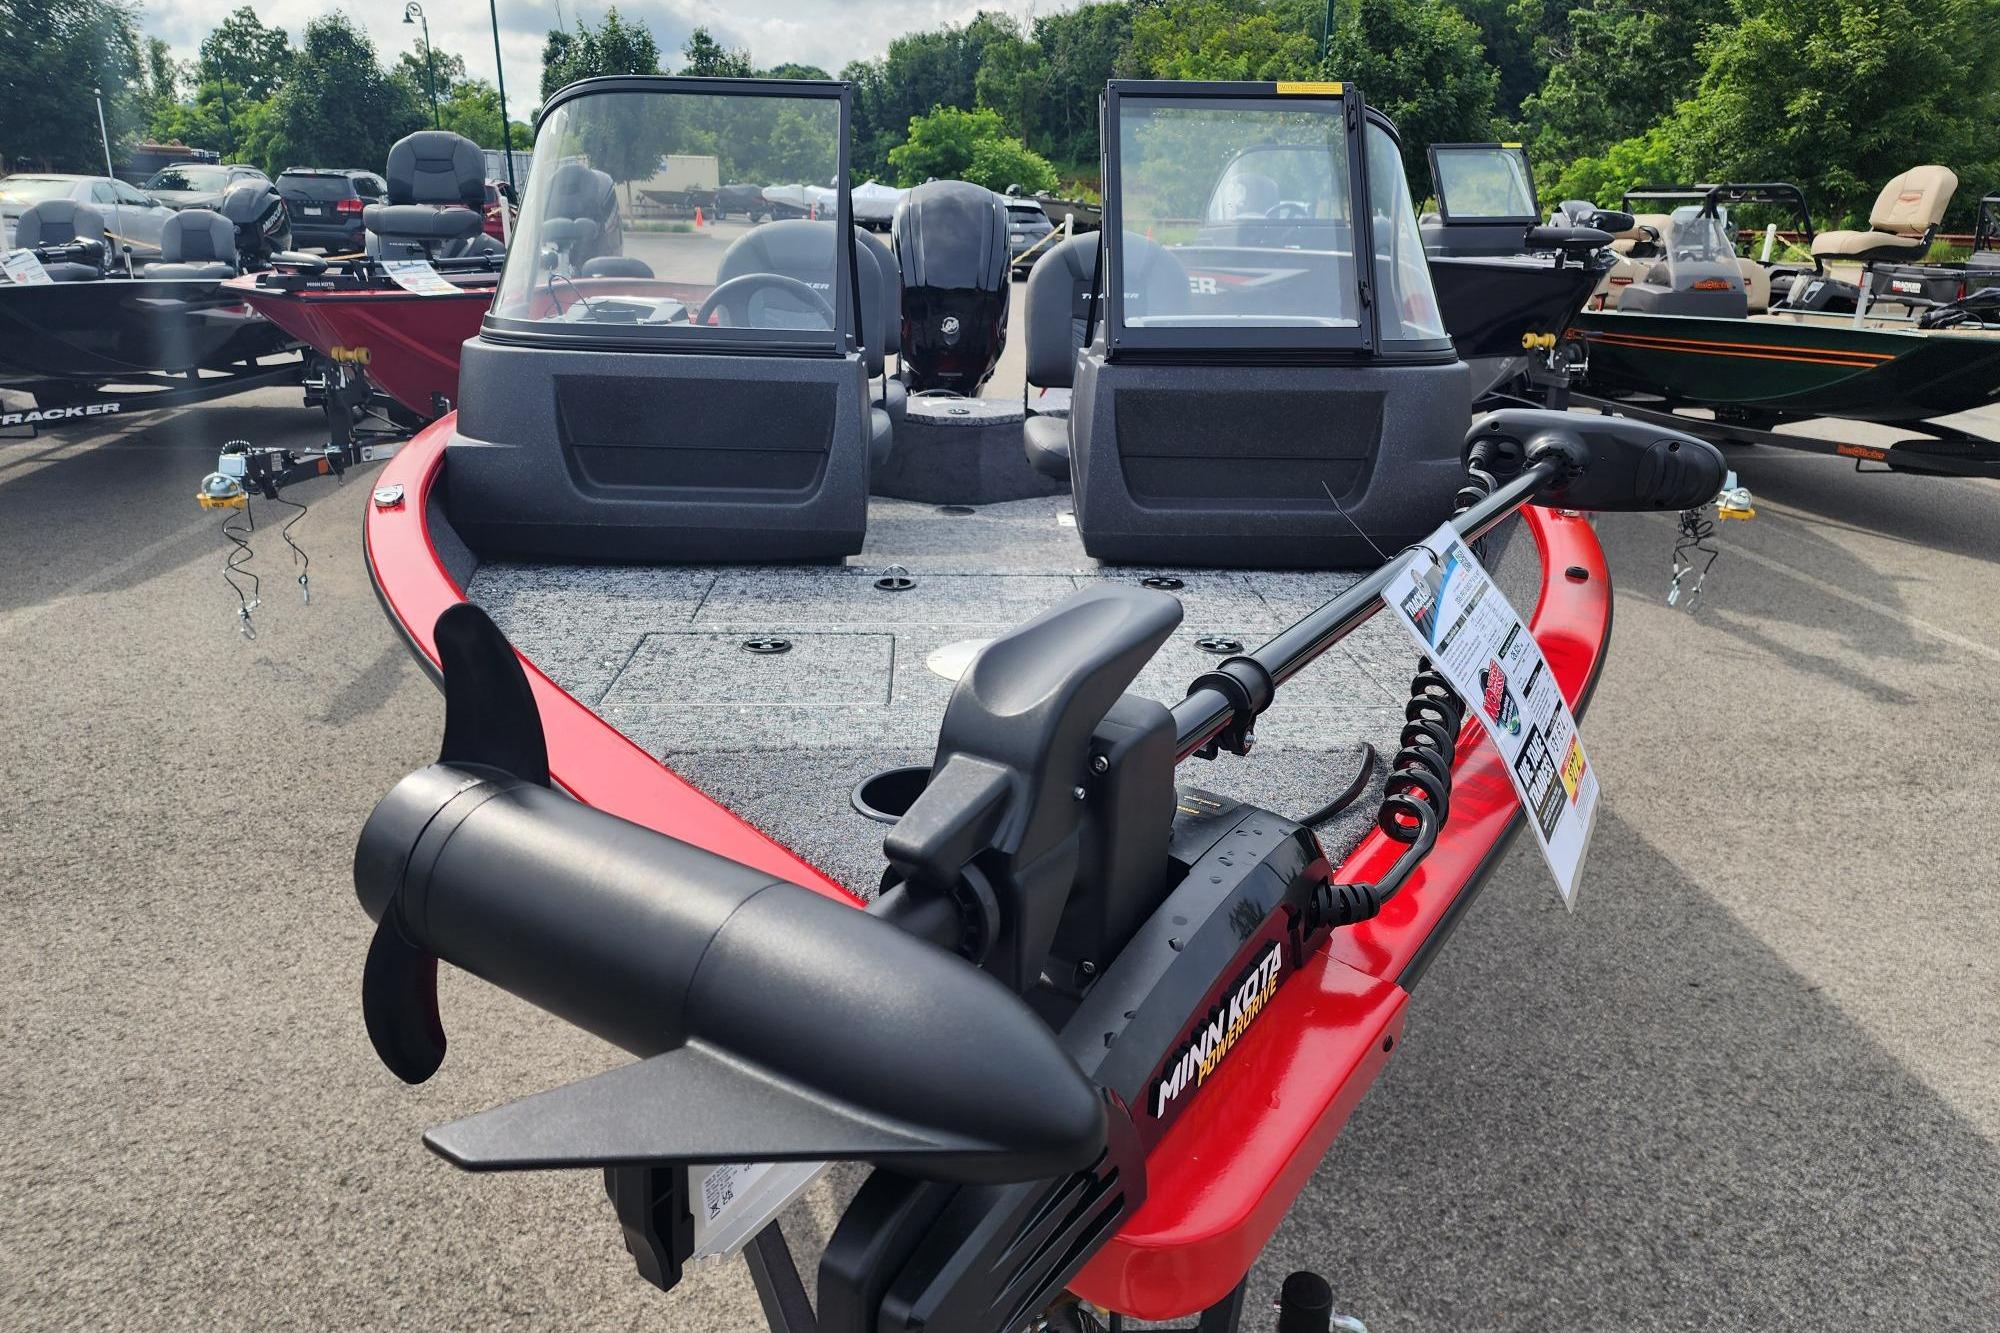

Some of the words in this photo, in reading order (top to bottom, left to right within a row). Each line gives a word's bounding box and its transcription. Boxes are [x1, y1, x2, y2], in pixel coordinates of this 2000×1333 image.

[0, 402, 121, 425] RACKER
[1518, 754, 1535, 788] WE
[1526, 731, 1546, 770] TAKE
[1528, 752, 1555, 812] TRADES!
[1157, 1008, 1225, 1120] MINN
[1227, 942, 1283, 1028] KOTA
[1197, 971, 1279, 1088] POWERDRIVE
